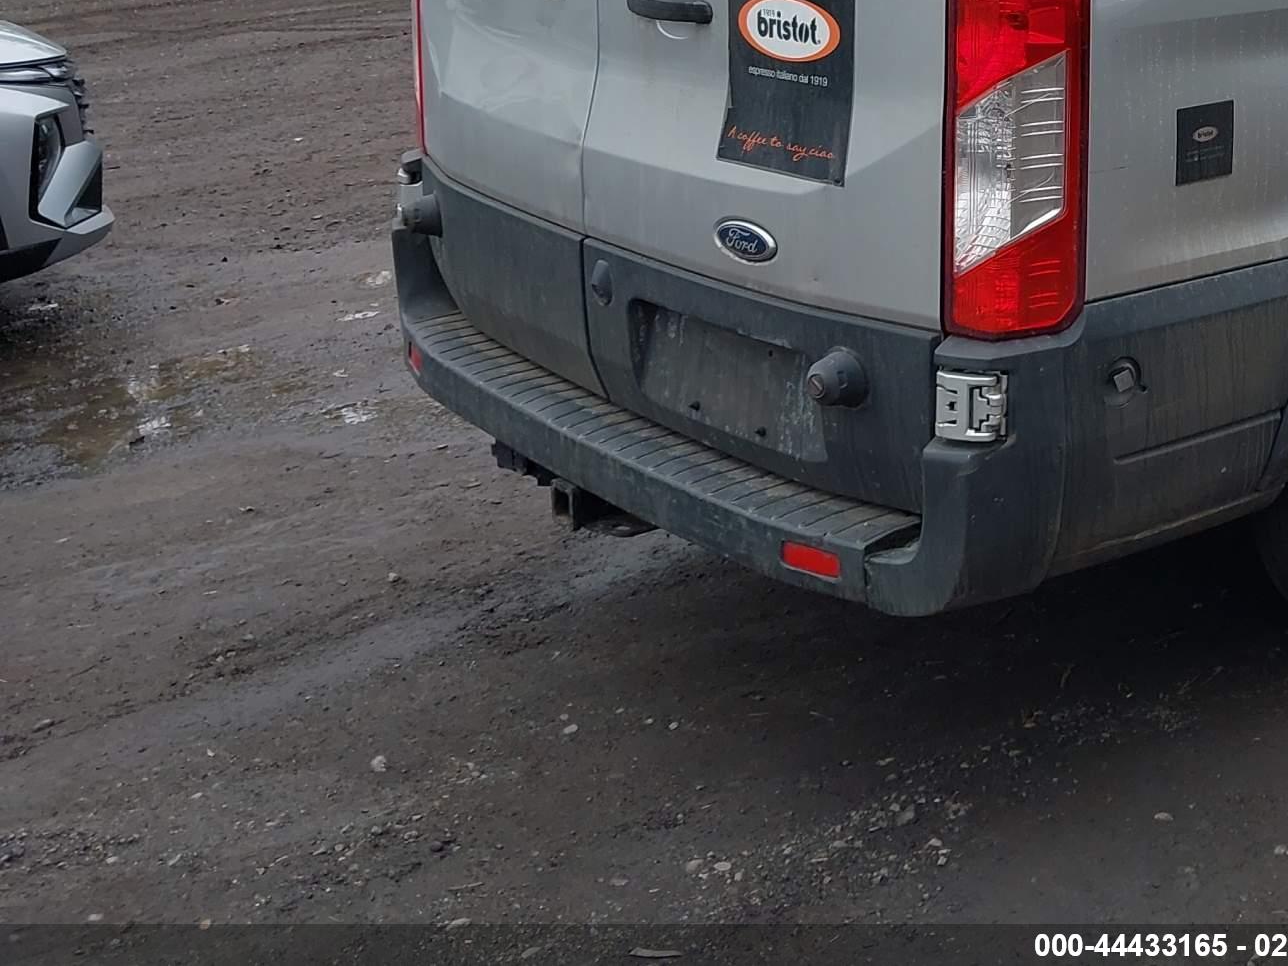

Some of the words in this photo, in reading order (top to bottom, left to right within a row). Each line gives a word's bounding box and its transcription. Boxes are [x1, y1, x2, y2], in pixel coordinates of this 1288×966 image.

[757, 9, 820, 45] bristot
[748, 65, 776, 78] espresso
[799, 73, 809, 84] dal
[809, 75, 828, 87] 1919
[738, 130, 768, 152] coffee
[770, 136, 782, 148] to
[726, 228, 758, 253] Ford
